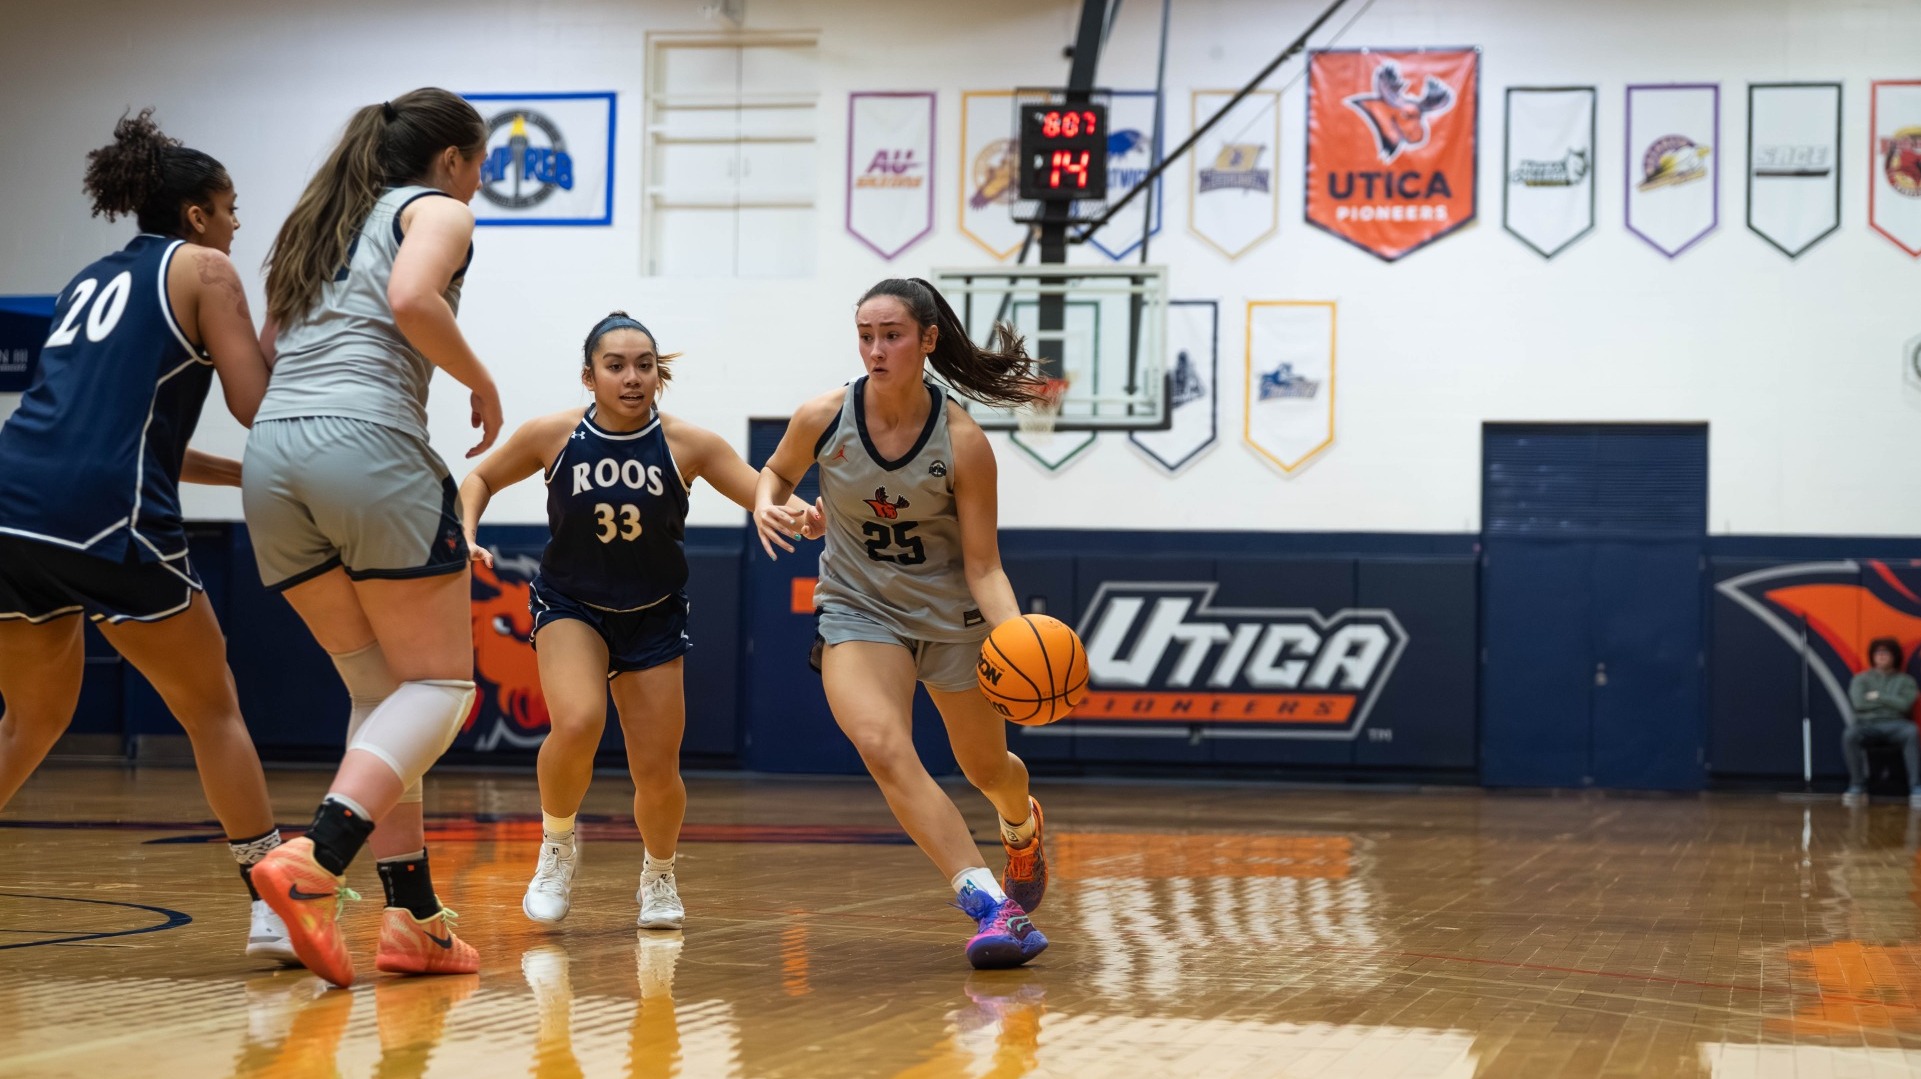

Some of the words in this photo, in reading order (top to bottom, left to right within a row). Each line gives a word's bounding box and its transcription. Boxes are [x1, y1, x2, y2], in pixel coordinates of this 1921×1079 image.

[1049, 151, 1090, 188] 14
[1328, 171, 1452, 199] UTICA
[1336, 205, 1447, 221] PIONEERS
[43, 270, 132, 348] 20
[571, 457, 664, 496] ROOS
[593, 502, 643, 544] 33
[861, 520, 927, 566] 25
[1088, 597, 1391, 689] UTICA
